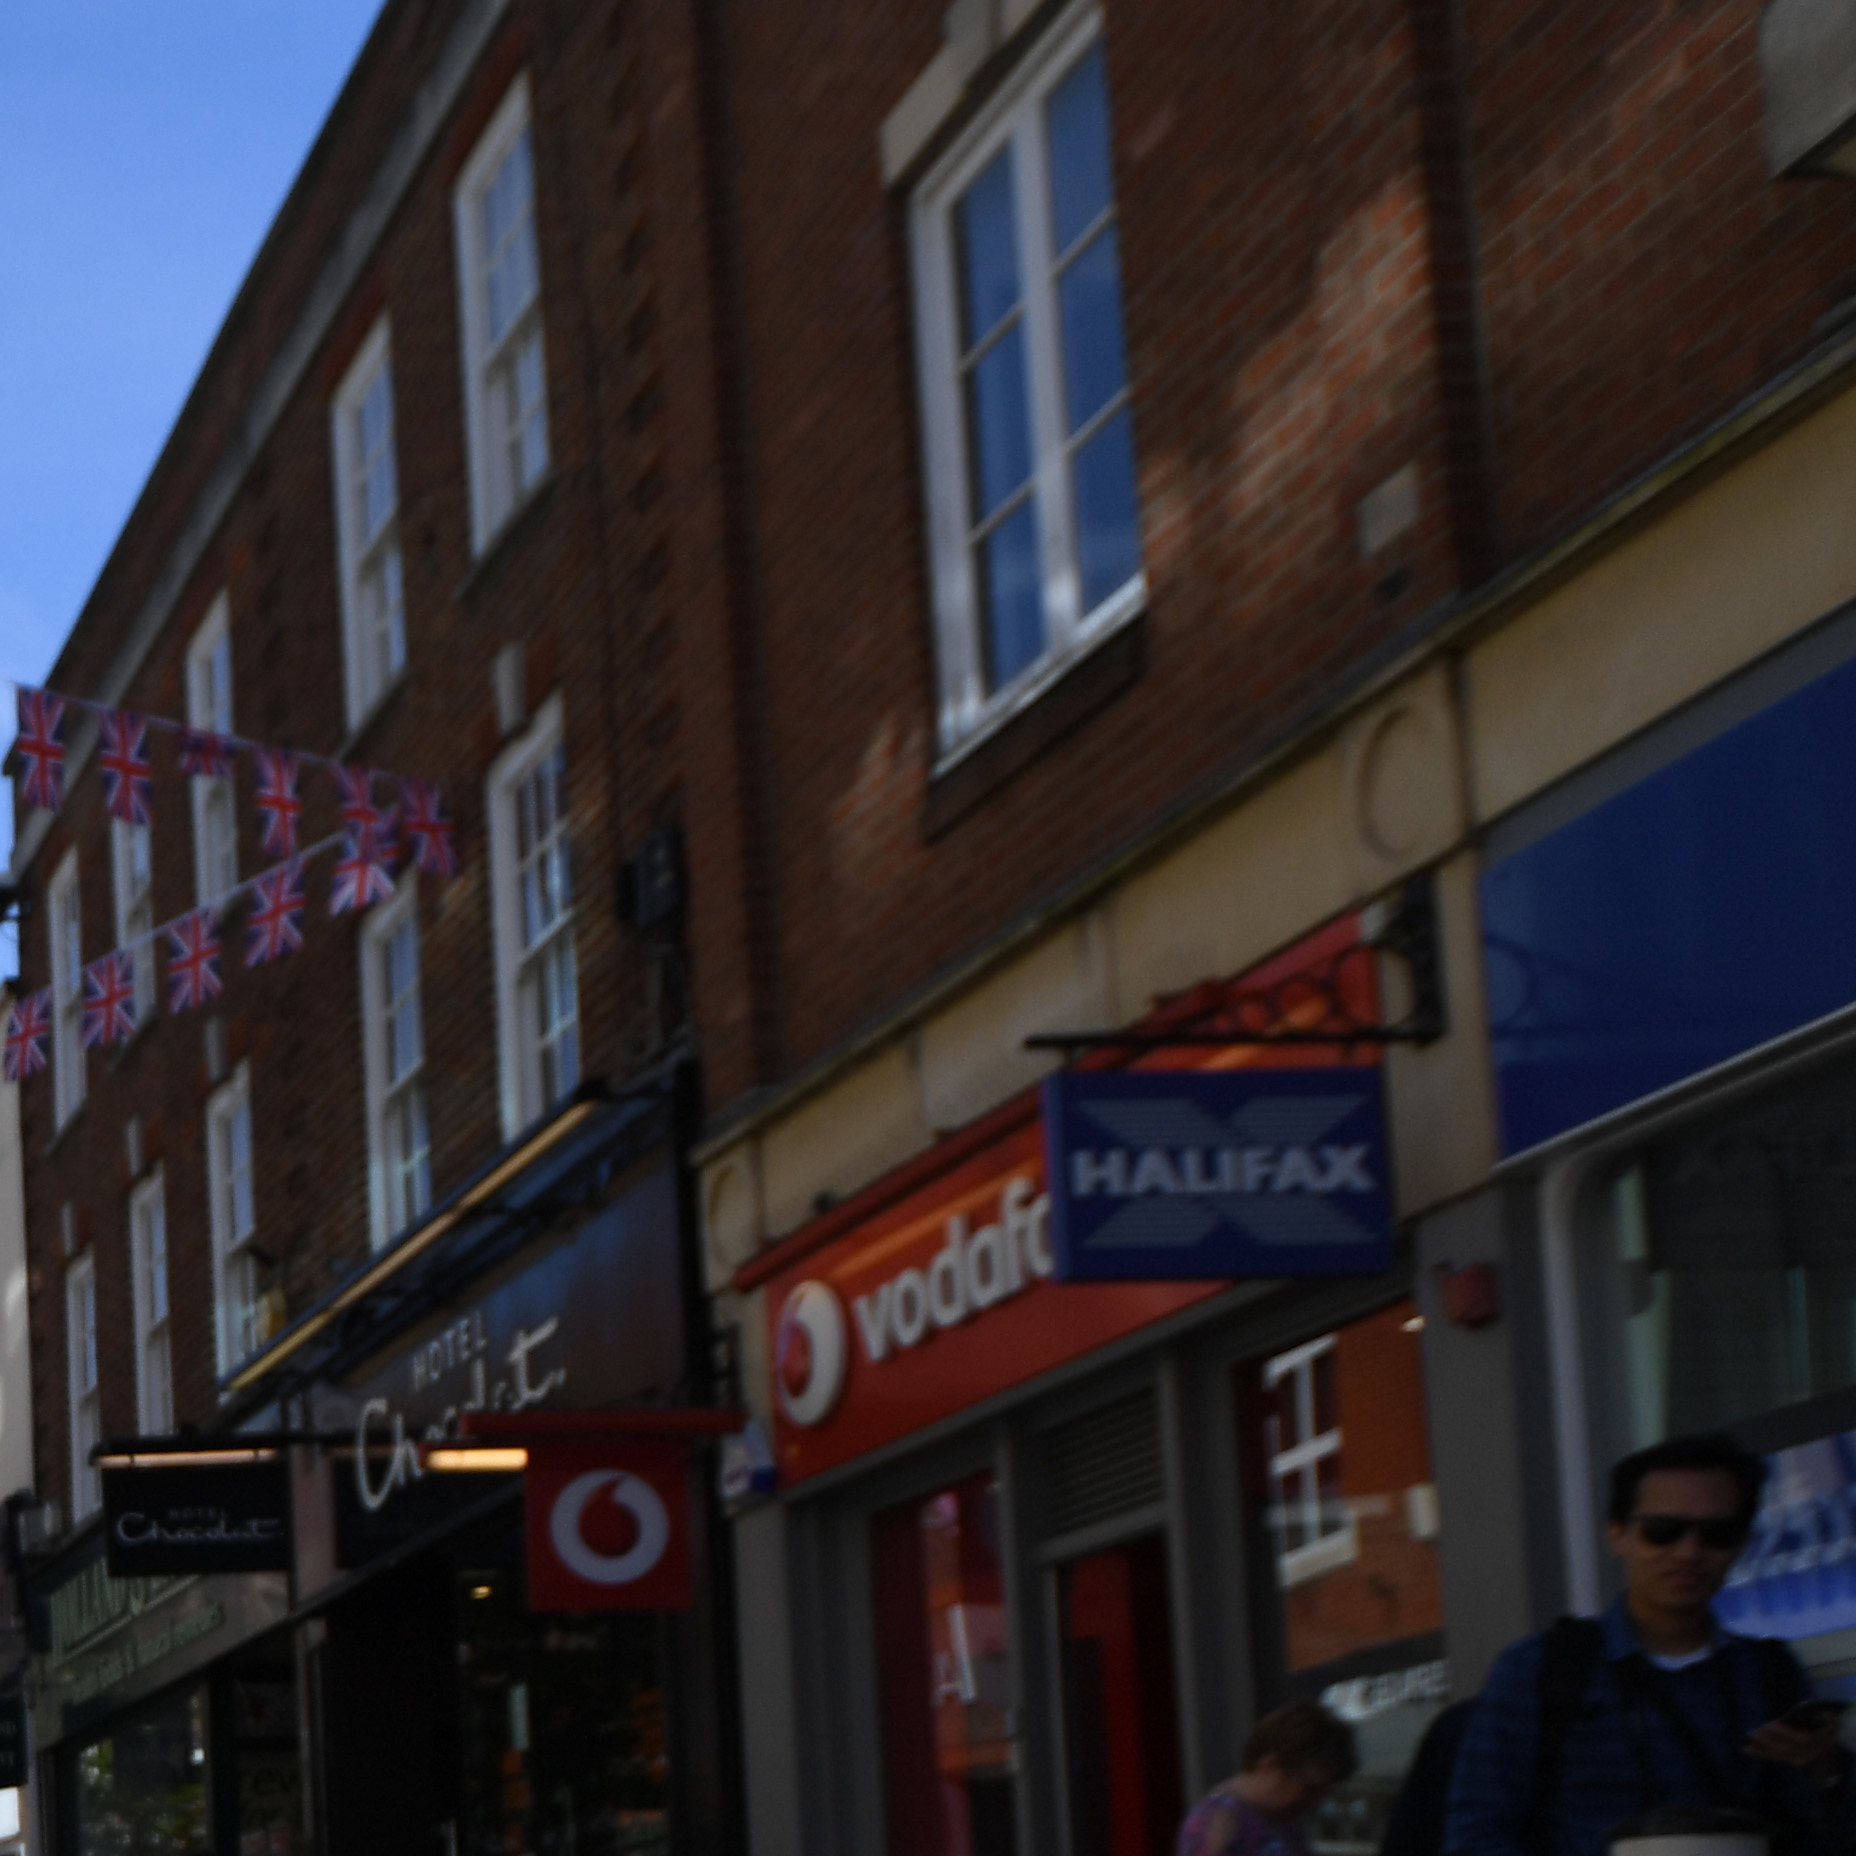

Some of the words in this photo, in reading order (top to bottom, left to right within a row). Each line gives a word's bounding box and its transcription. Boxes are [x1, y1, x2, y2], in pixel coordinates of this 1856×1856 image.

[1071, 1143, 1381, 1198] HALIFAX
[854, 1175, 1054, 1364] vodafo
[412, 1310, 487, 1393] HOTEL
